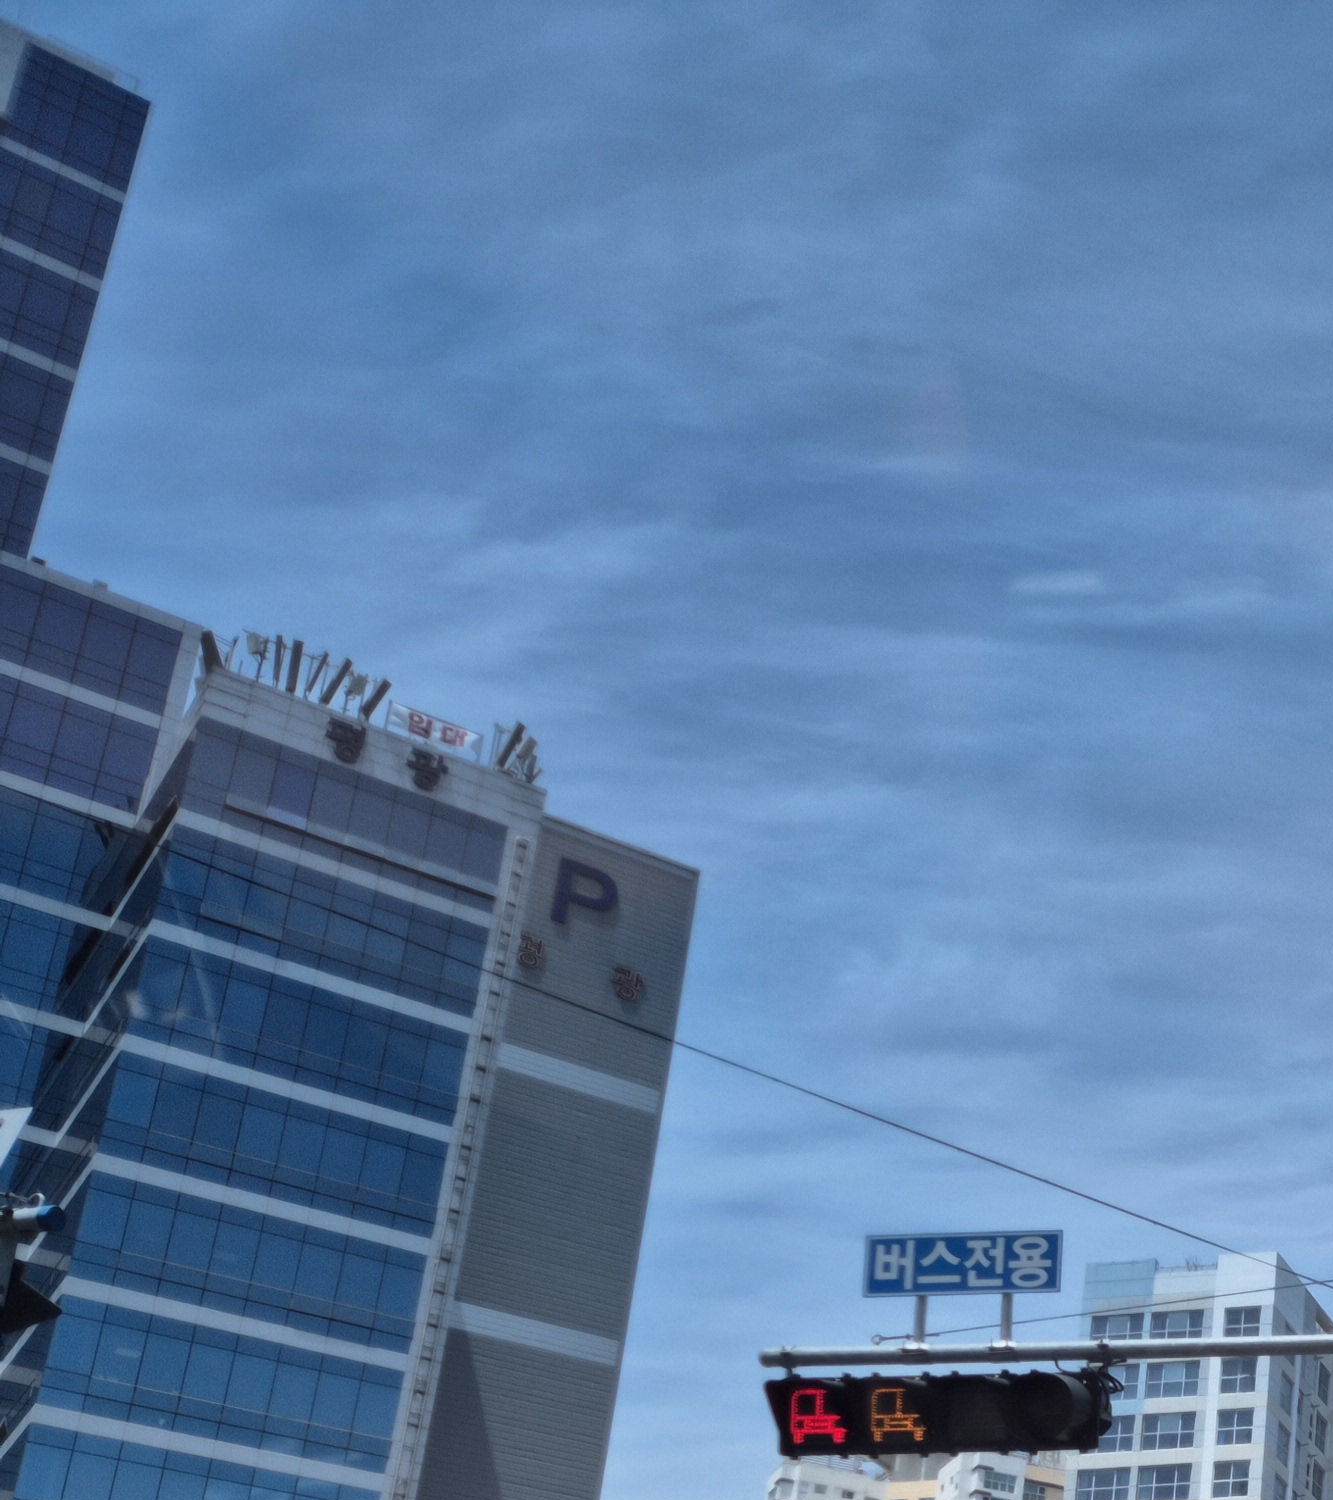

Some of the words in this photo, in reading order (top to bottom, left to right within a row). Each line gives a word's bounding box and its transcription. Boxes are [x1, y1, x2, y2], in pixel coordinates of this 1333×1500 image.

[407, 711, 468, 748] 임대
[551, 857, 619, 925] P
[873, 1236, 1053, 1290] 버스전용
